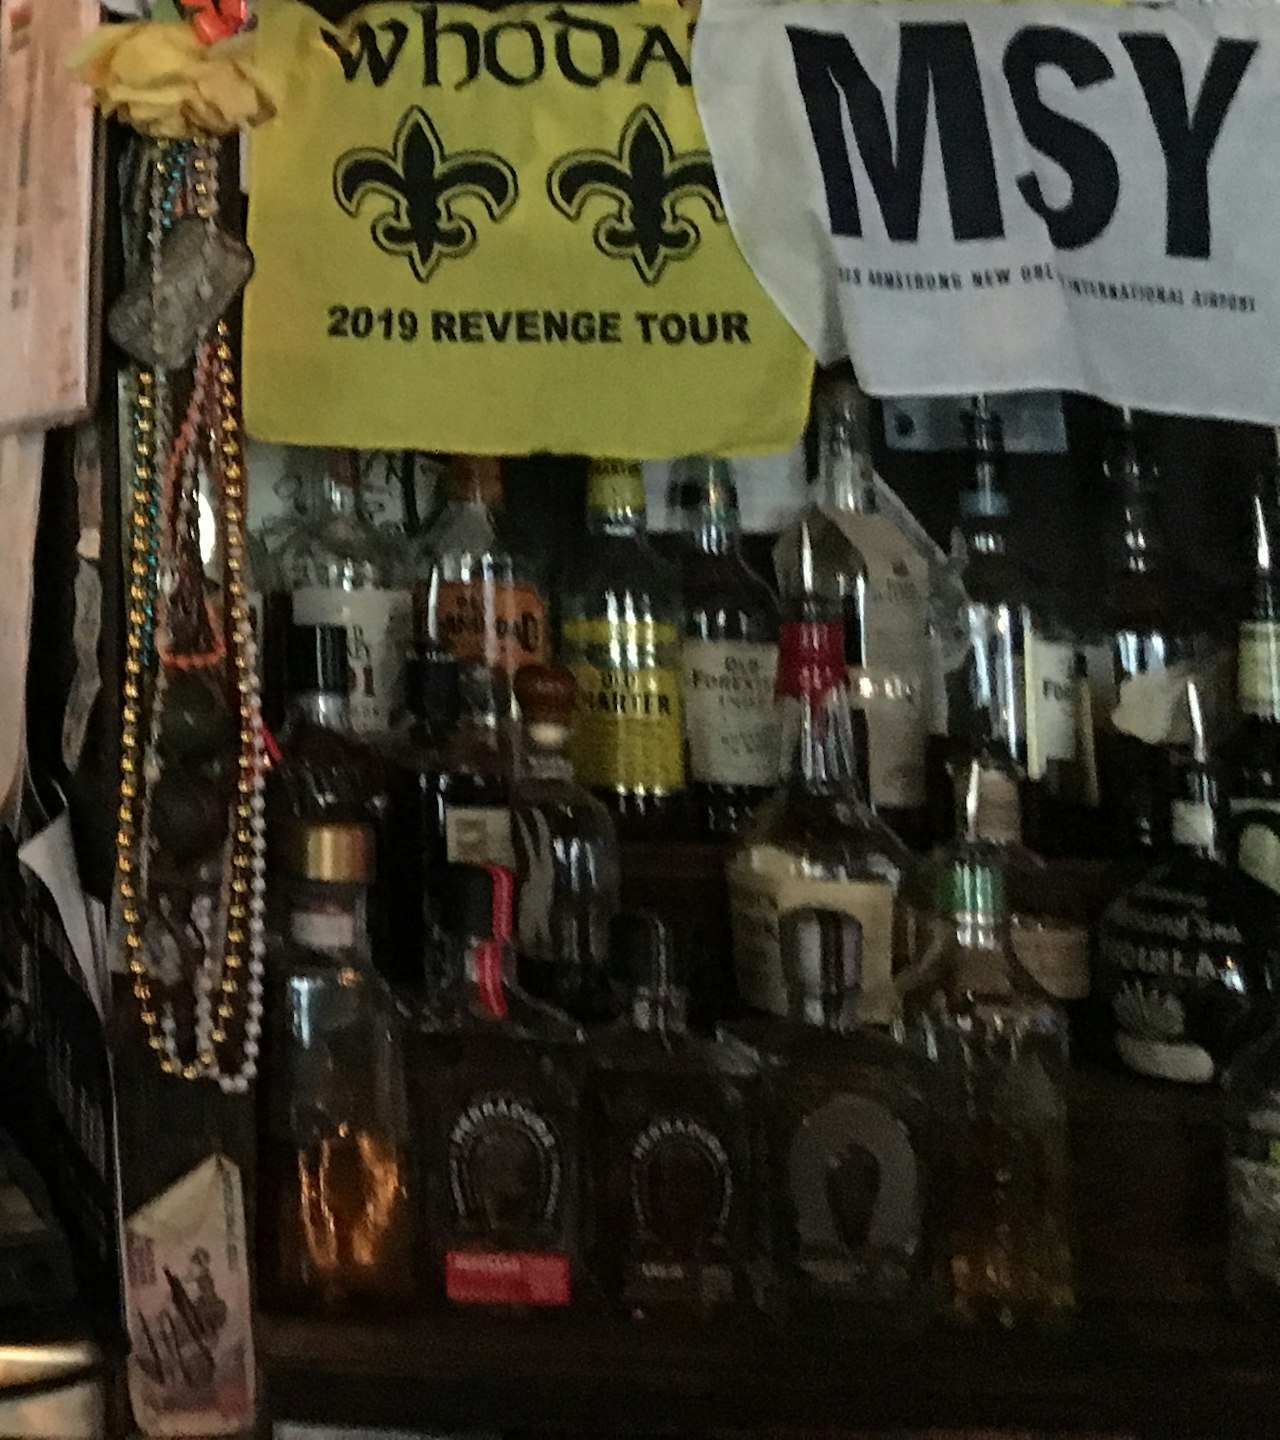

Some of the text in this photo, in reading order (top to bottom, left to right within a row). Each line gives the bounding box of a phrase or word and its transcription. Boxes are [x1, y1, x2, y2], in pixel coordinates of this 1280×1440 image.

[784, 18, 1260, 262] MSY
[972, 268, 1011, 289] NEW
[326, 304, 751, 345] 2019 REVENGE TOUR
